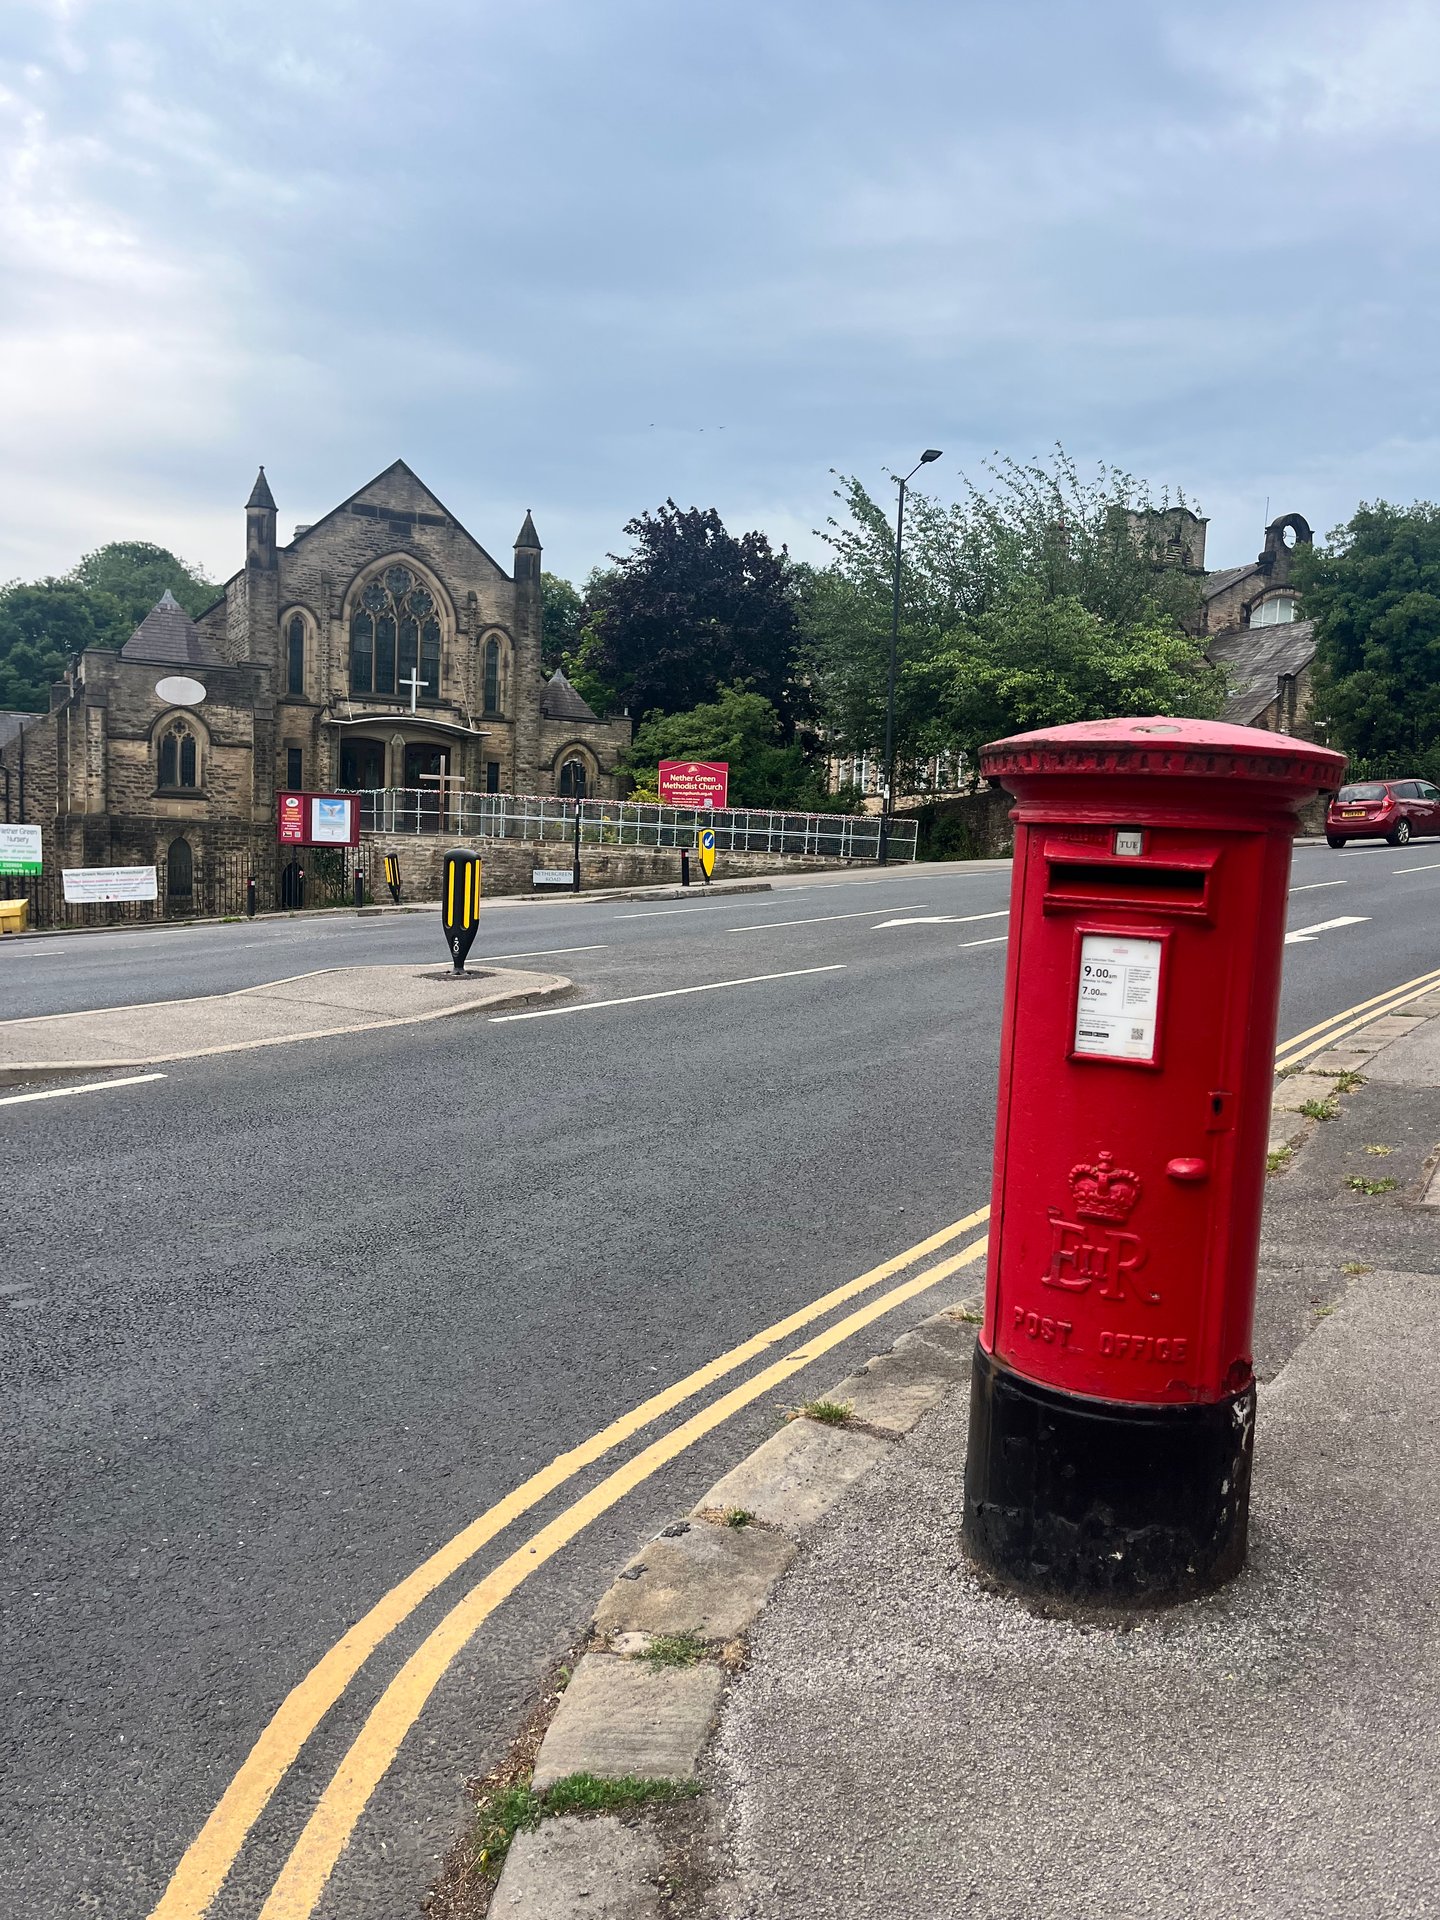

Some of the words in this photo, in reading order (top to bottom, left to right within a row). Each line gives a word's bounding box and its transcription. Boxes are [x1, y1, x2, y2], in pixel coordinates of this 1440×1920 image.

[20, 827, 38, 836] Green
[7, 836, 30, 844] Nursery
[1120, 840, 1139, 849] TUE
[1013, 1305, 1073, 1348] POST
[1099, 1331, 1189, 1363] OFFICE
